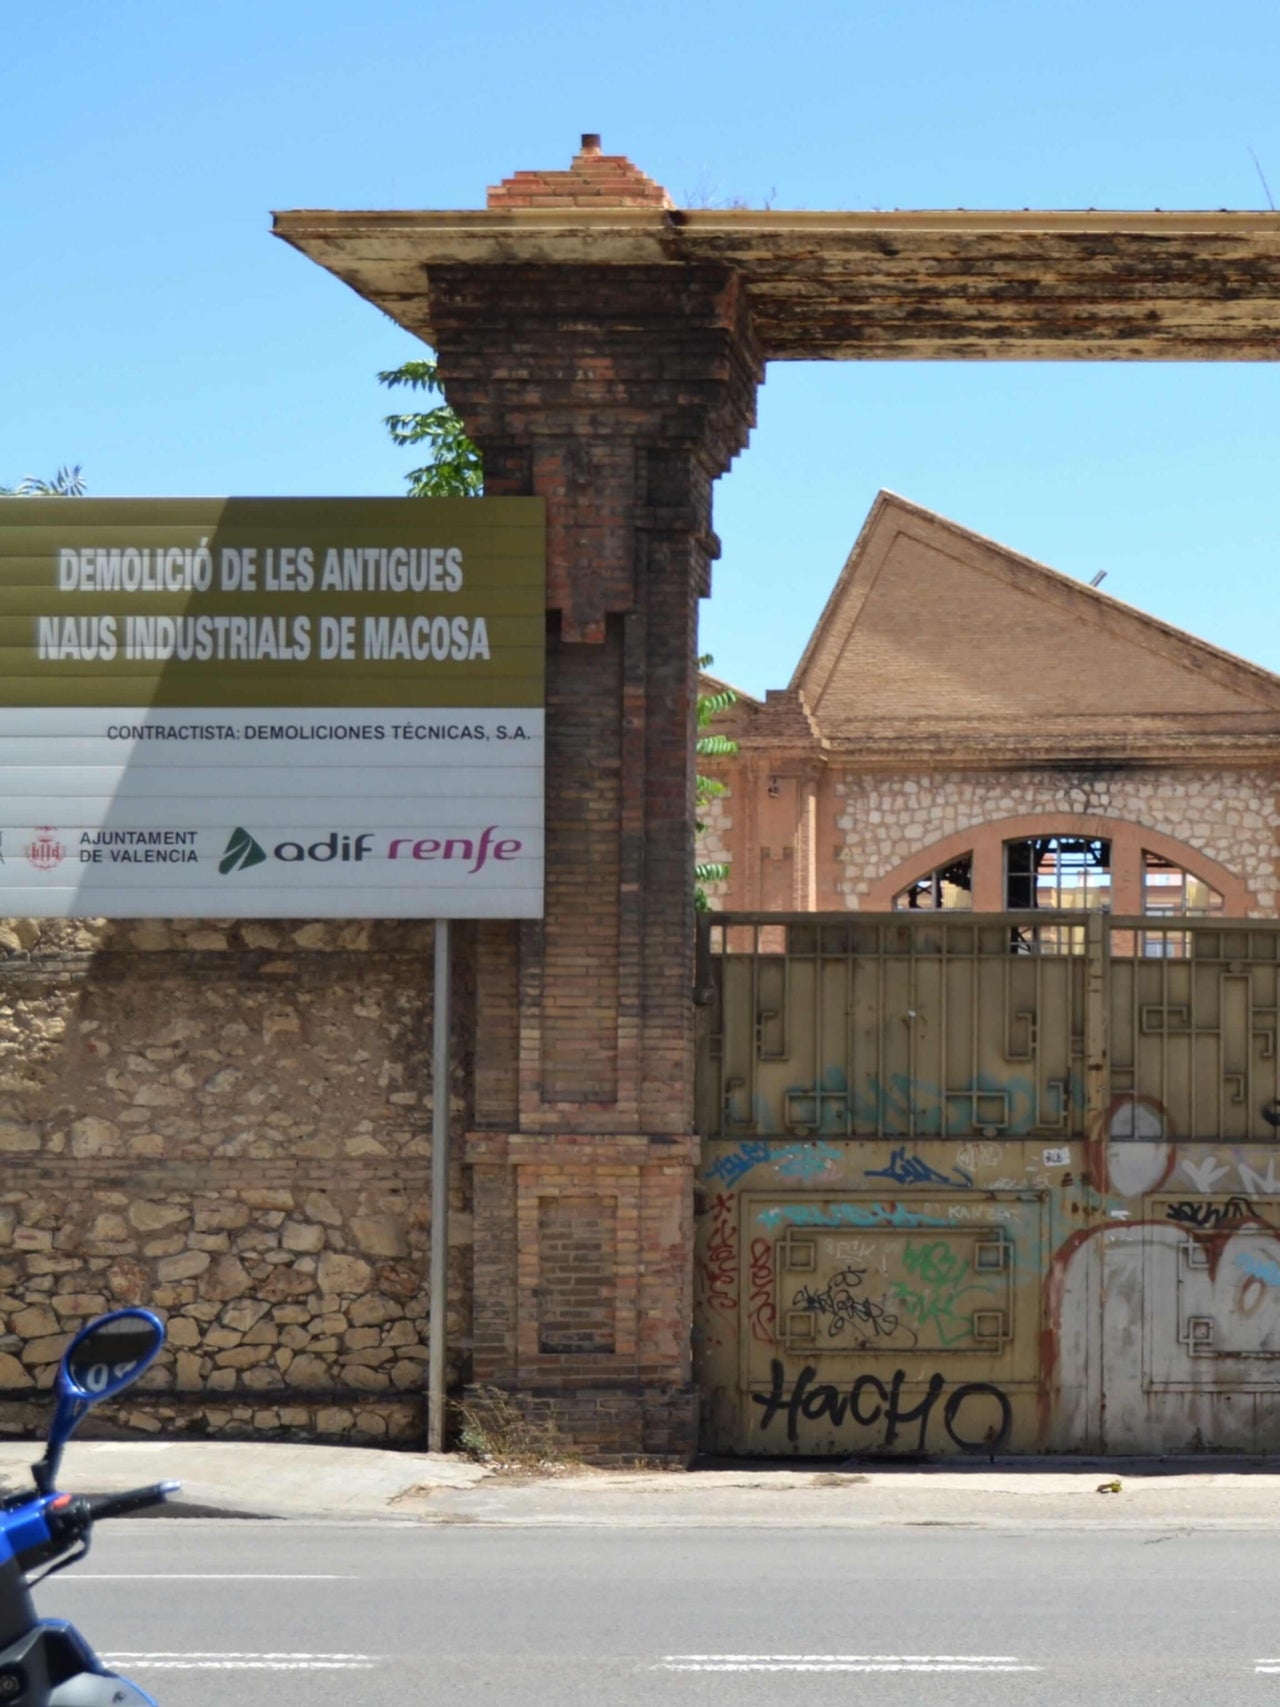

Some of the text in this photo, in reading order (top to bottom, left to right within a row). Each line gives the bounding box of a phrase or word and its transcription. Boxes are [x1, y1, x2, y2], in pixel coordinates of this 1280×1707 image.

[59, 537, 463, 592] DEMOLICIÓ DE LES ANTIGUES
[38, 616, 490, 660] NAUS INDUSTRIALS DE MACOSA
[107, 722, 531, 742] CONTRACTISTA: DEMOLICIONES TÉCNICAS, S.A.
[80, 831, 198, 845] AJUNTAMENT
[274, 833, 375, 862] adif
[387, 825, 522, 874] renfe
[80, 849, 198, 863] DE VALENCIA
